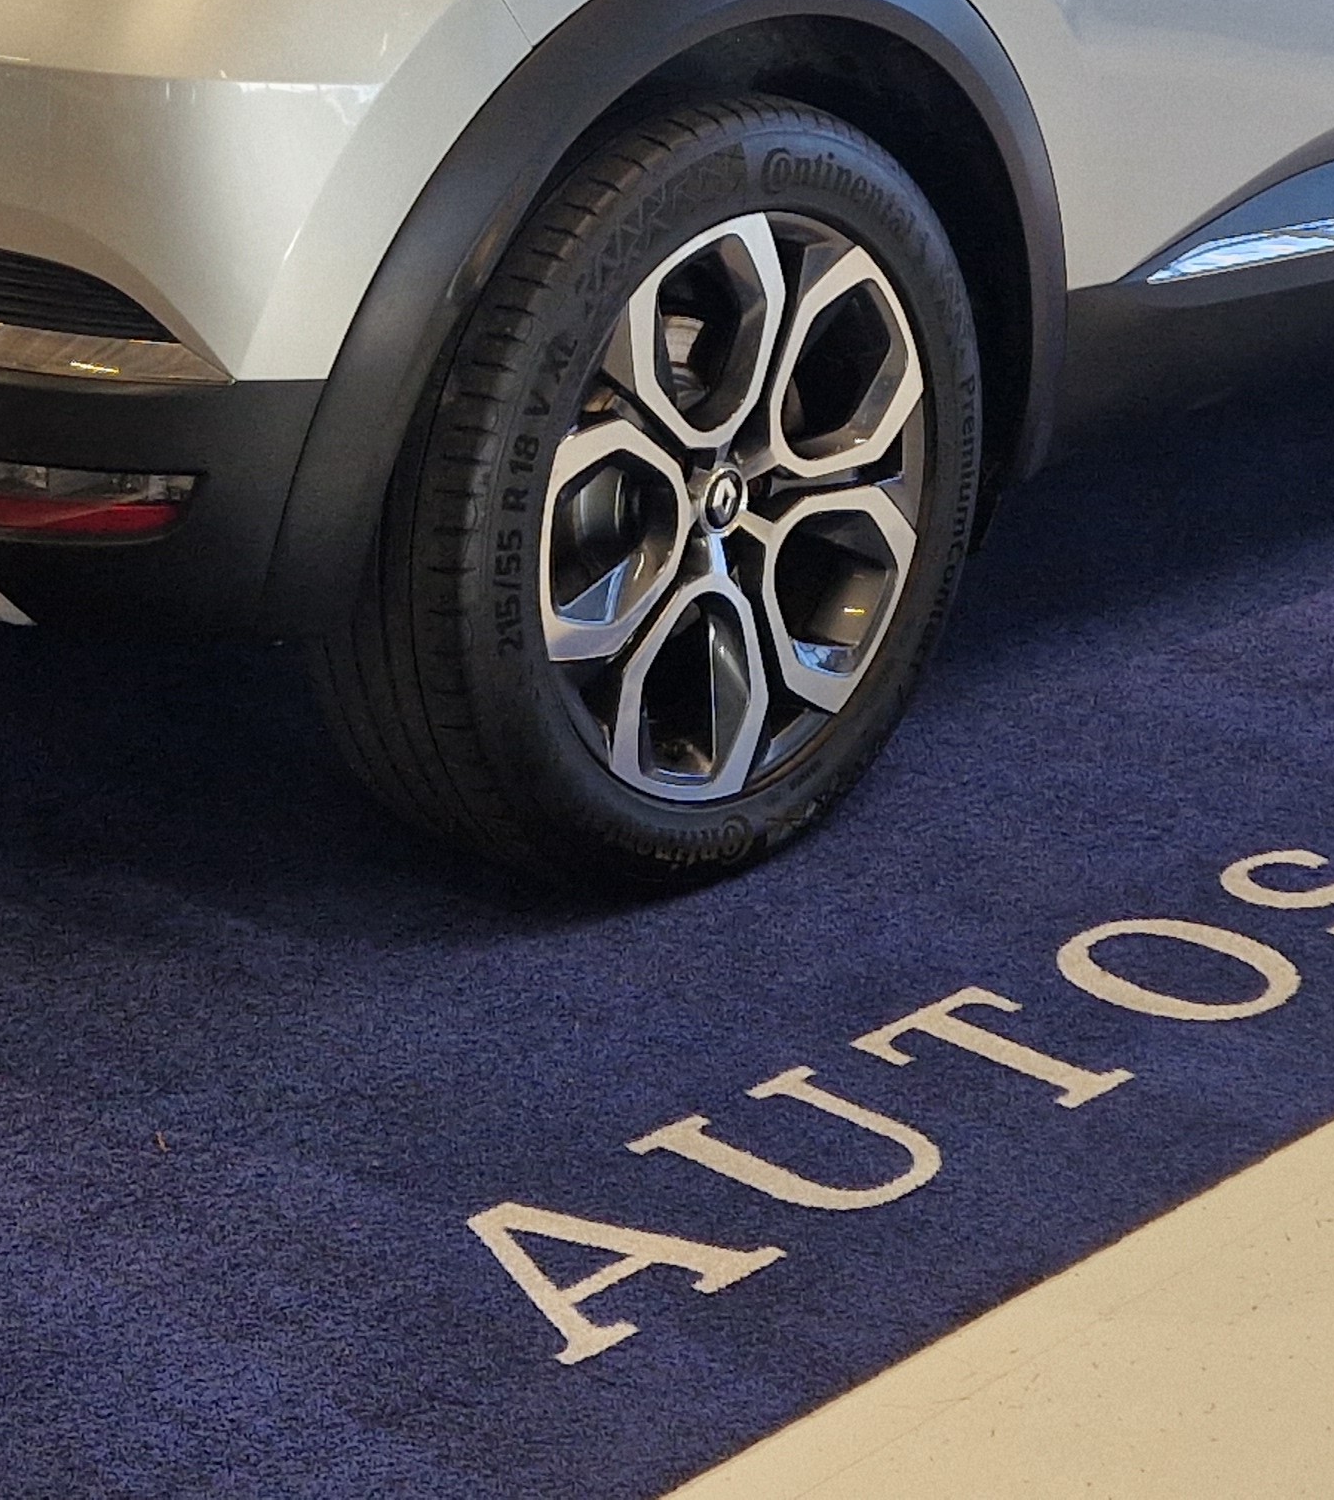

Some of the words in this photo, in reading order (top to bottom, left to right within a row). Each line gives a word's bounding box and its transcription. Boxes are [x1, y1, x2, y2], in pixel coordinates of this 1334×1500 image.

[762, 147, 917, 238] Continental
[524, 391, 550, 416] V
[510, 434, 539, 474] 18
[502, 486, 530, 513] R
[493, 529, 523, 657] 215/55
